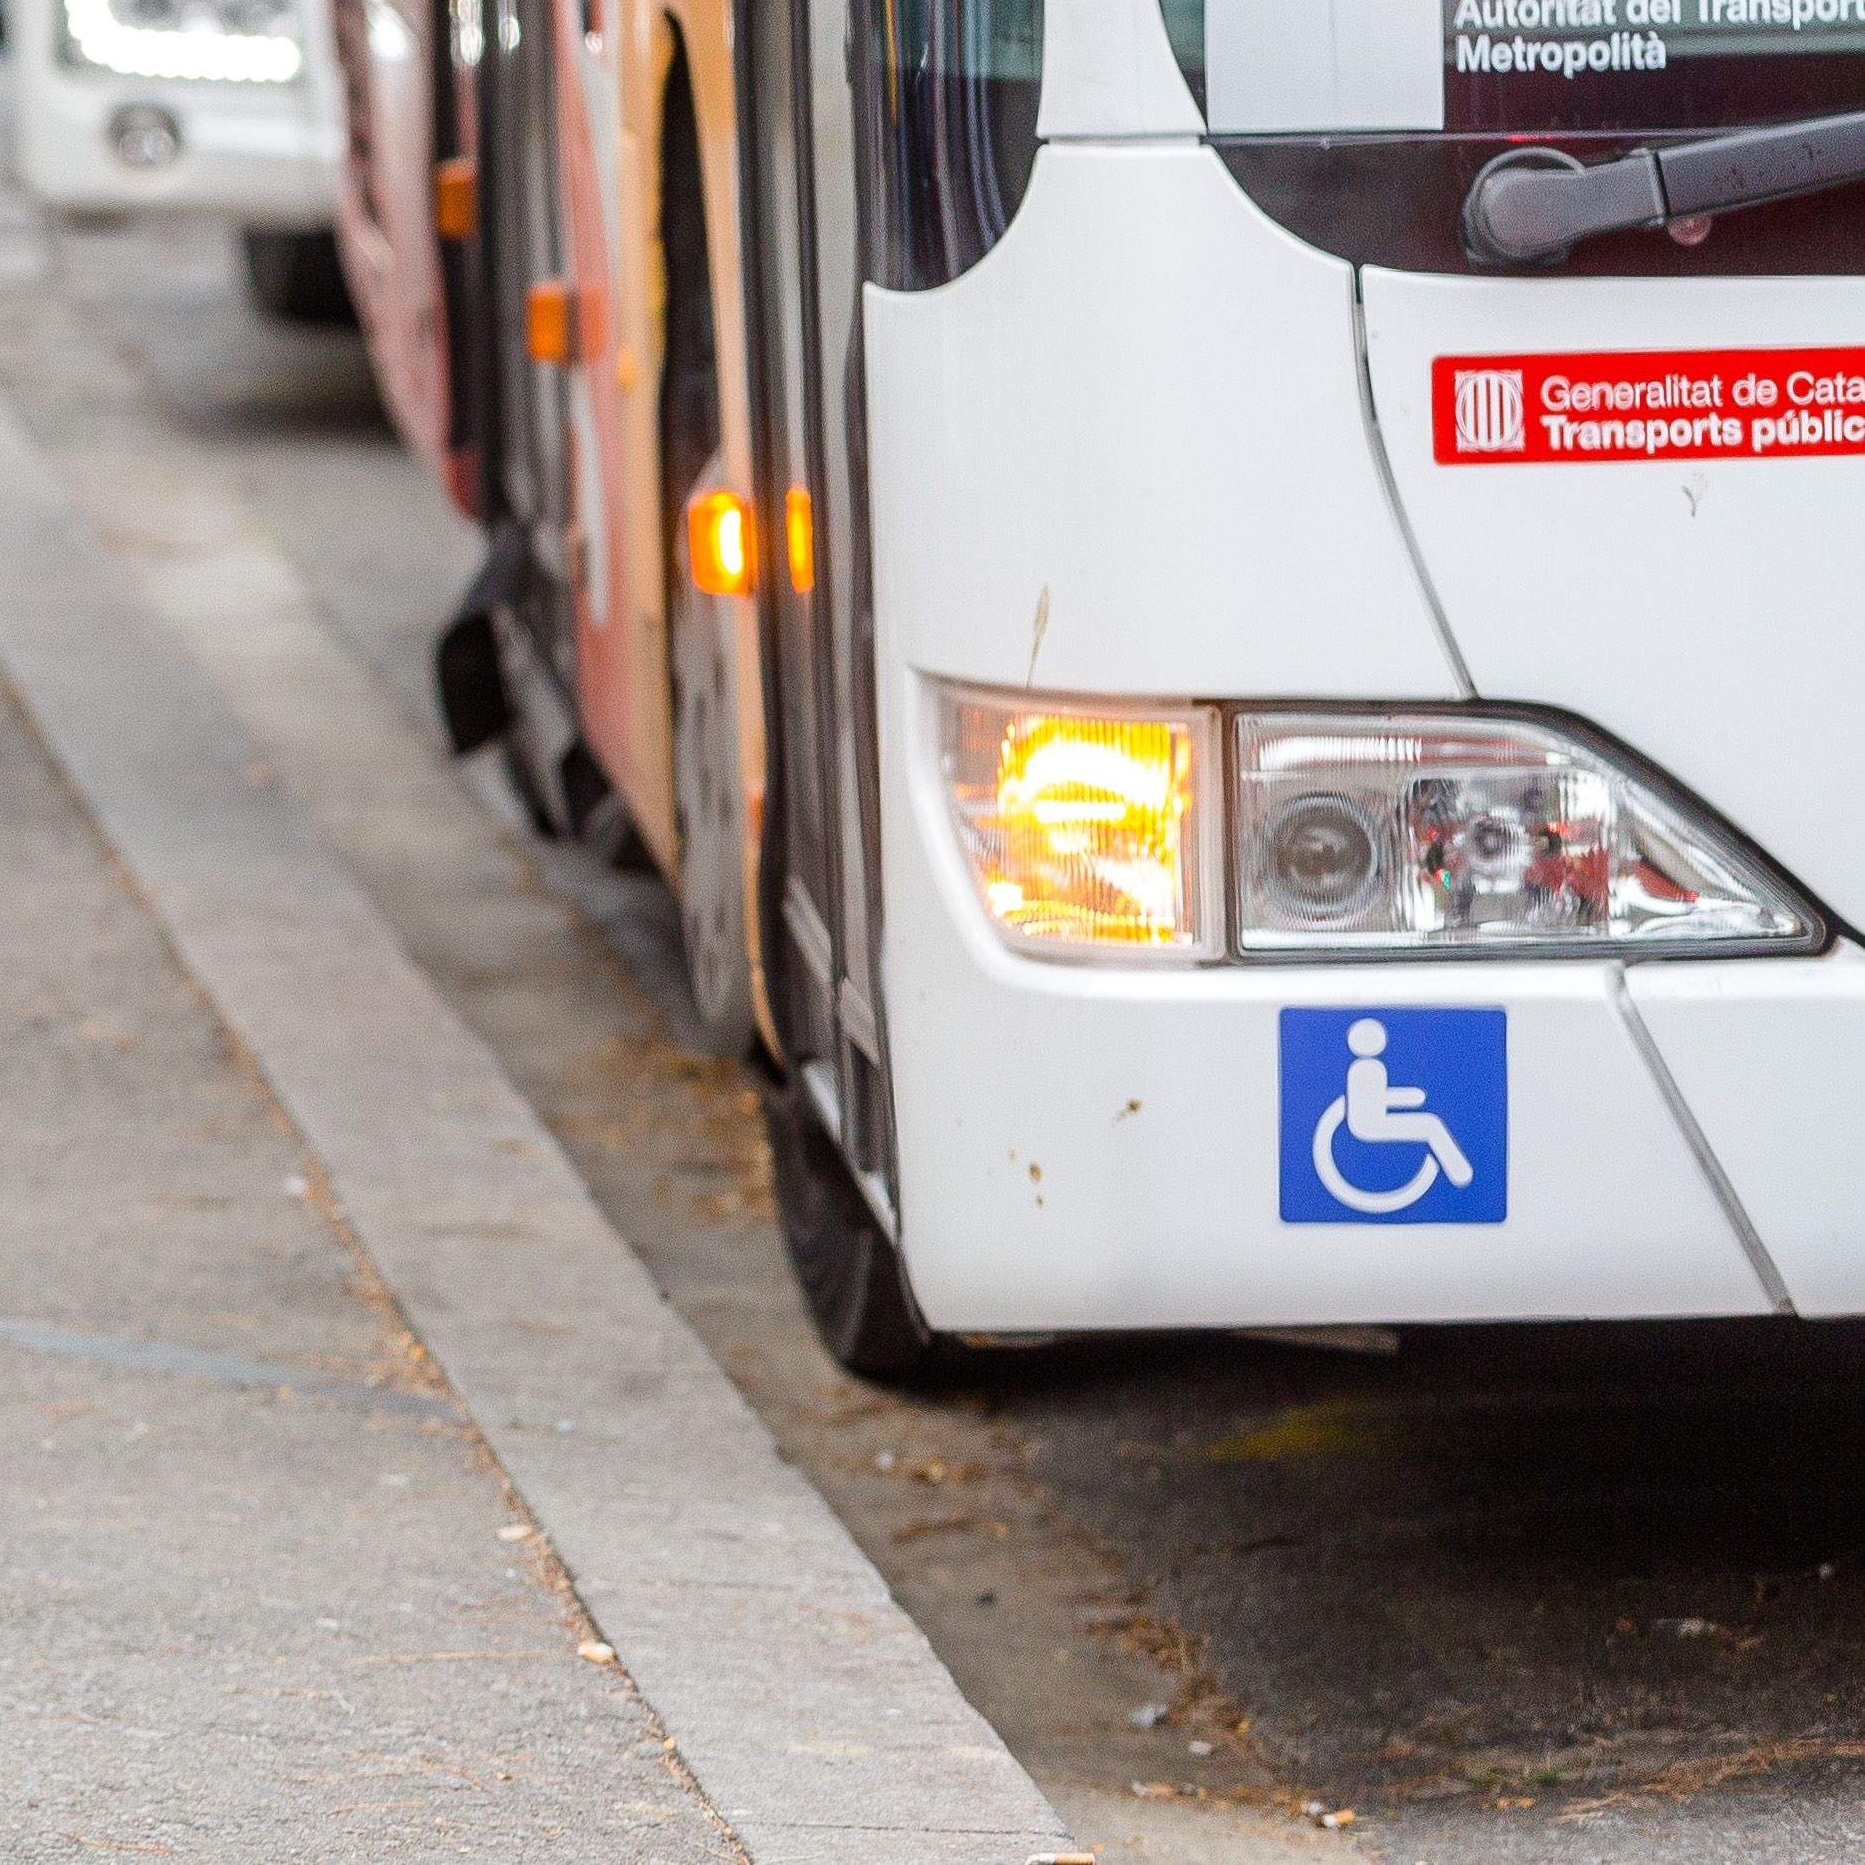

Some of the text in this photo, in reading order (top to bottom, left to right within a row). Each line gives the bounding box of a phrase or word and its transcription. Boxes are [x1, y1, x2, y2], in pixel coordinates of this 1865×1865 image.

[1456, 31, 1666, 79] Metropolità
[1540, 373, 1722, 411] Generalitat
[1731, 372, 1778, 406] de
[1540, 411, 1742, 454] Transports
